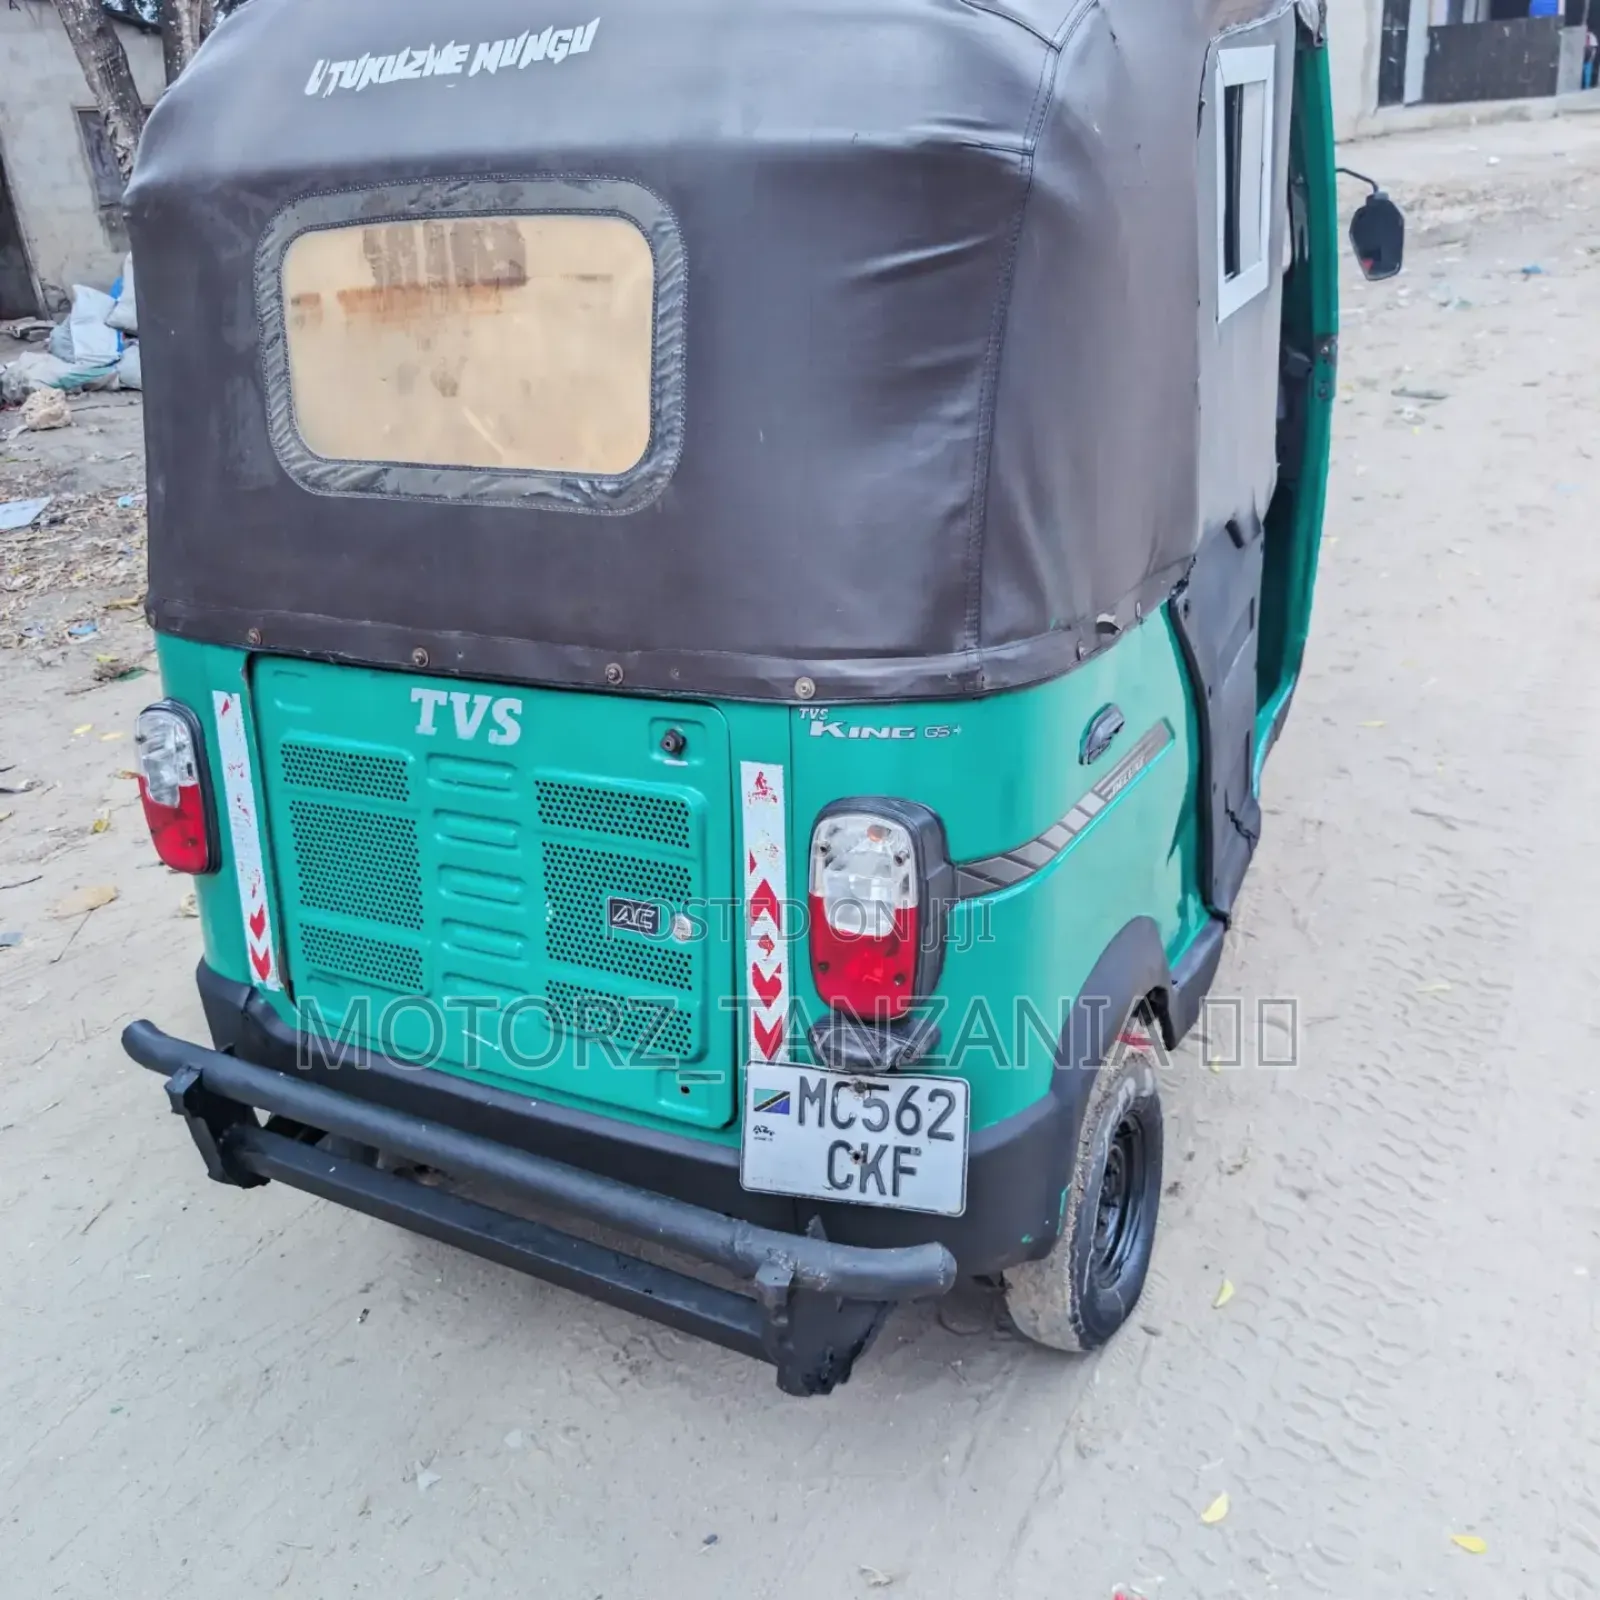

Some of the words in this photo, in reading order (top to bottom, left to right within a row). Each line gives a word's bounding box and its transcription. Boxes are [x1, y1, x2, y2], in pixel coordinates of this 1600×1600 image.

[304, 40, 471, 98] UTUKUZWE
[468, 17, 601, 77] MUNGU
[410, 687, 523, 746] TVS
[799, 708, 829, 720] TVS
[798, 1075, 957, 1142] MC562
[827, 1139, 922, 1198] CKF
